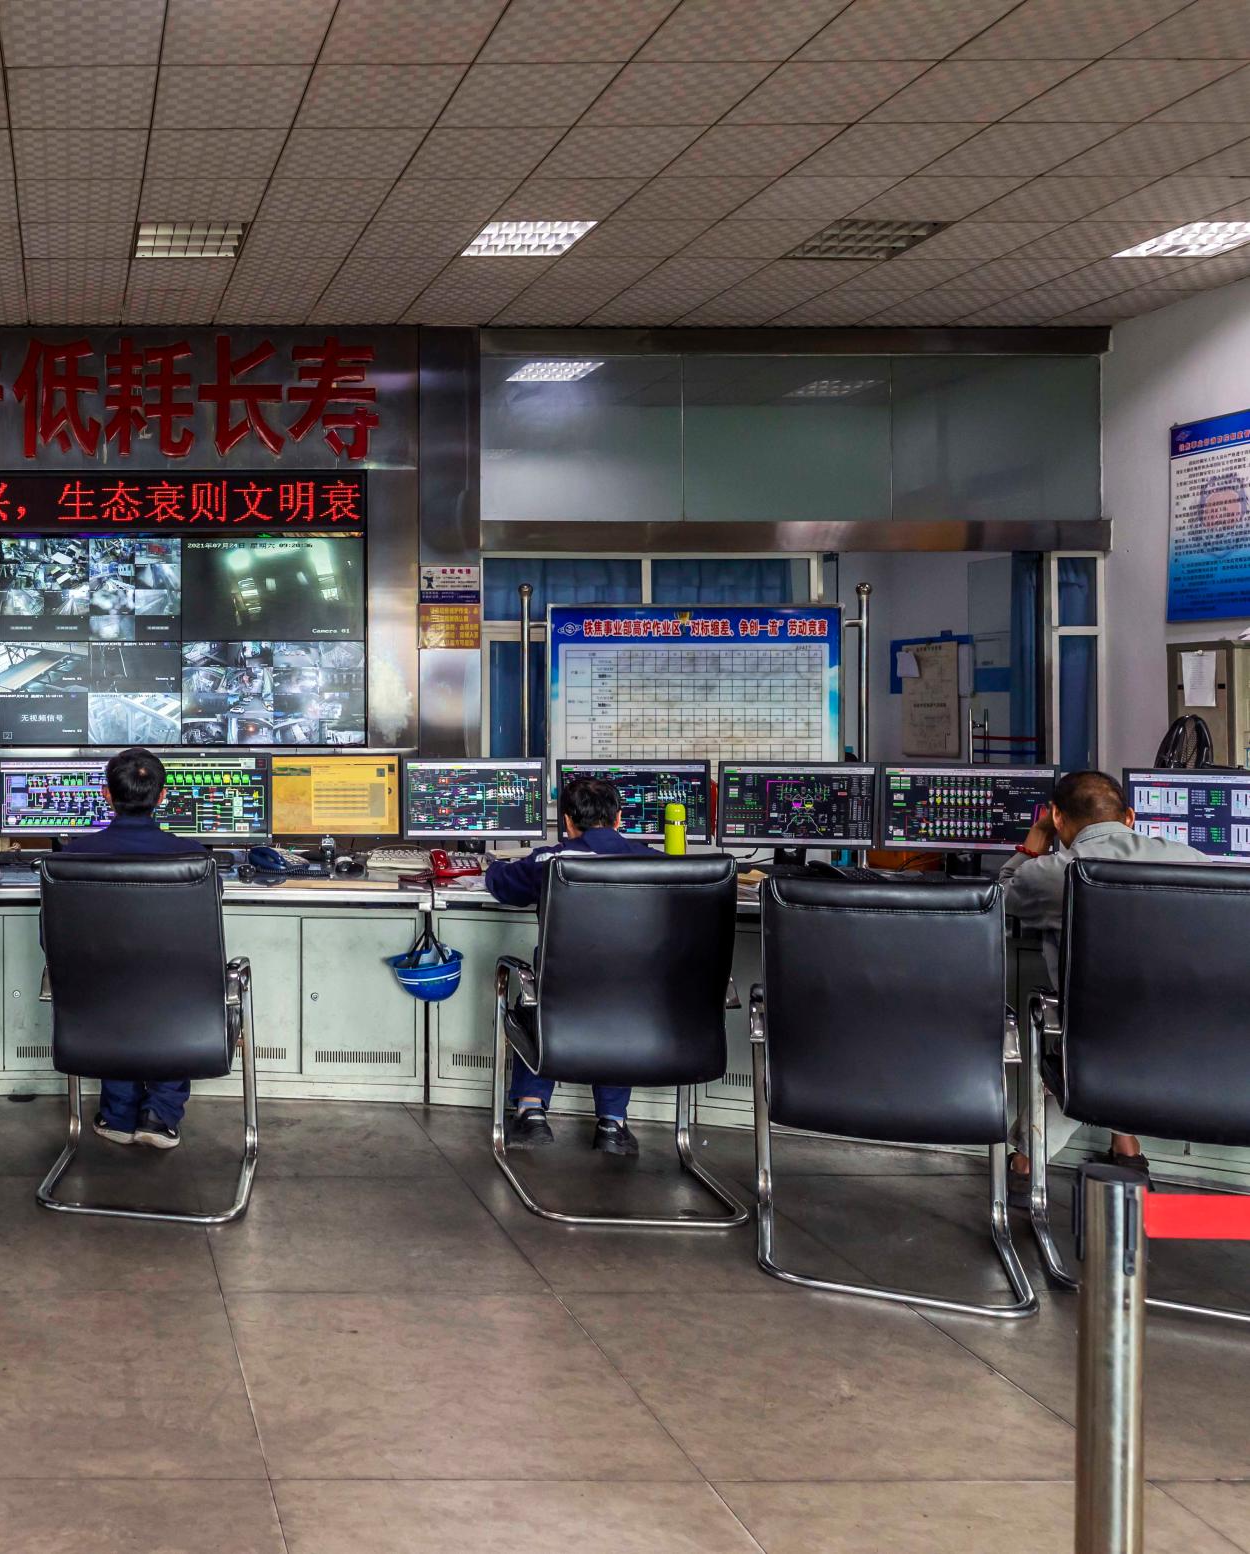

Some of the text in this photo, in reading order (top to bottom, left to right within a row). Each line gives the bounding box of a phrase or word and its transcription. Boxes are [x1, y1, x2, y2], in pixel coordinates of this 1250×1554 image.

[583, 618, 828, 637] 铁焦事业部高炉作业区“对标缩差、争创一流”劳动竞赛
[21, 714, 63, 722] 无视频信号
